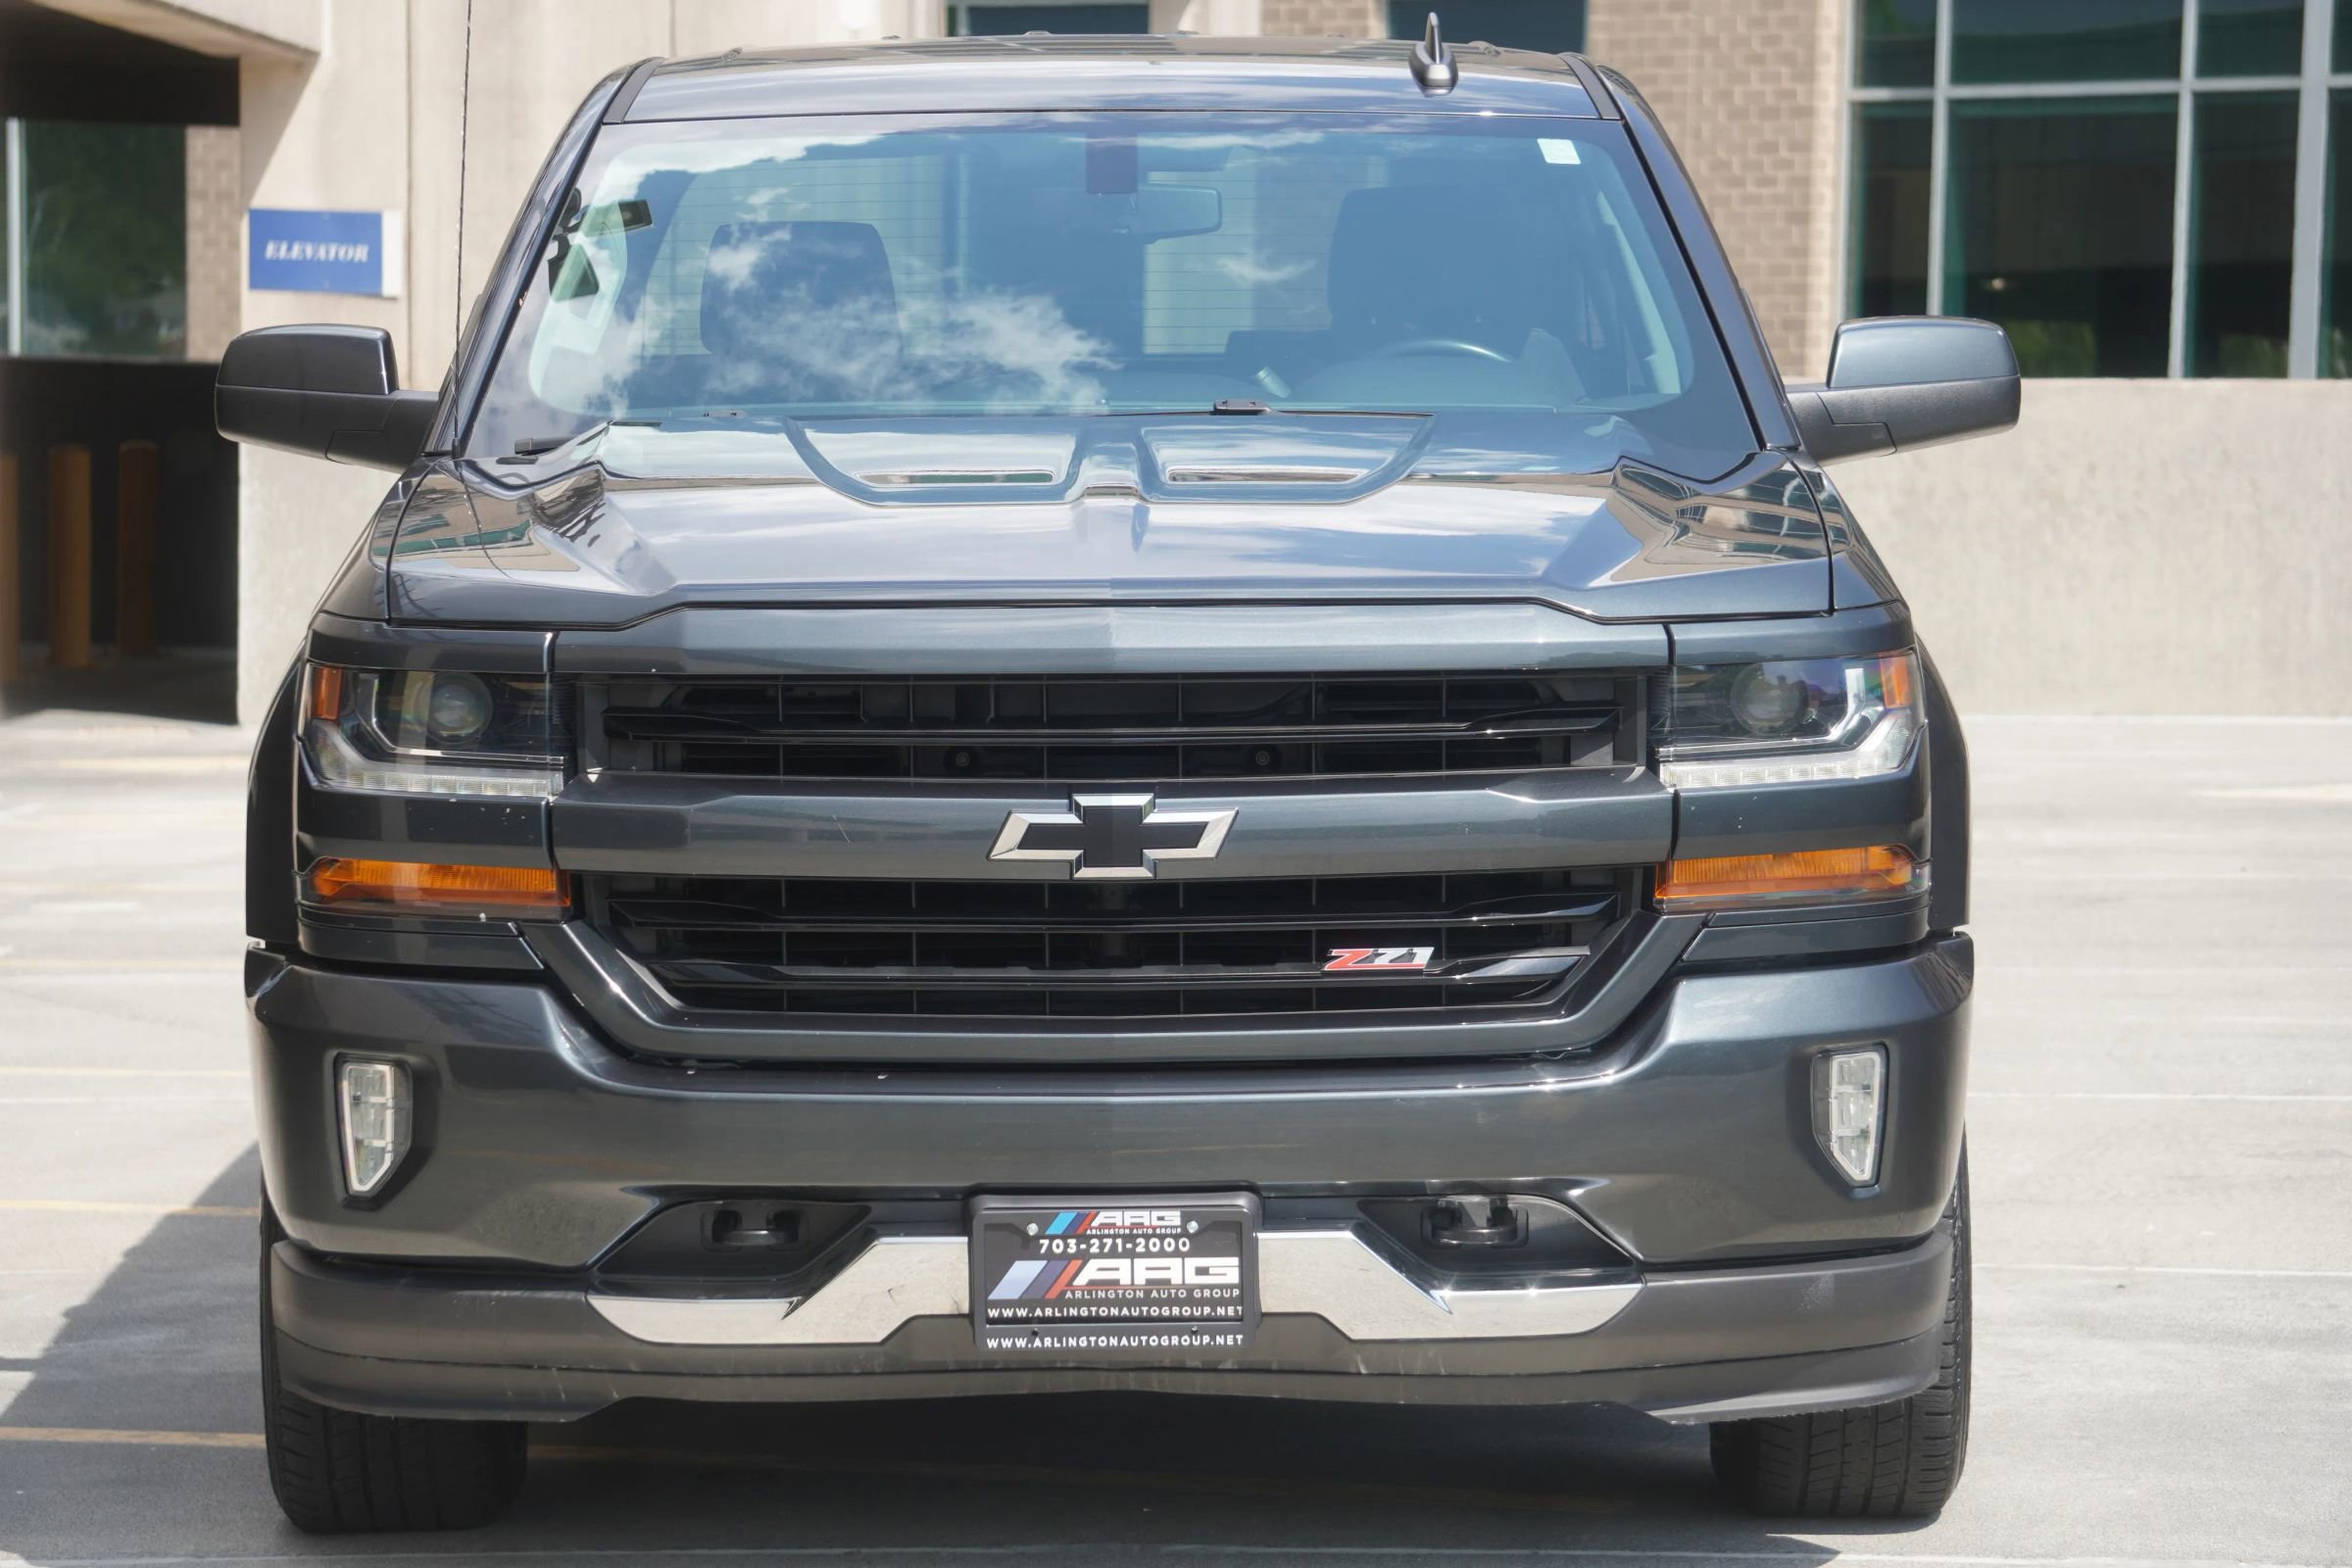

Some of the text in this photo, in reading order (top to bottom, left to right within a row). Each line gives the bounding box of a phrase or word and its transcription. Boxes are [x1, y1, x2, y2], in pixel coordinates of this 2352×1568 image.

[266, 240, 368, 263] ELEVATOR
[1325, 947, 1435, 970] Z71
[1090, 1210, 1181, 1226] AAG
[1039, 1237, 1191, 1253] 703-271-2000
[1072, 1256, 1240, 1286] AAG
[1064, 1288, 1240, 1299] ARLINGTON AUTO GROUP
[987, 1305, 1243, 1318] WWW.ARLINGTONAUTOGROUP.NET
[986, 1334, 1244, 1348] WWW.ARLINGTONAUTOGROUP.NET
